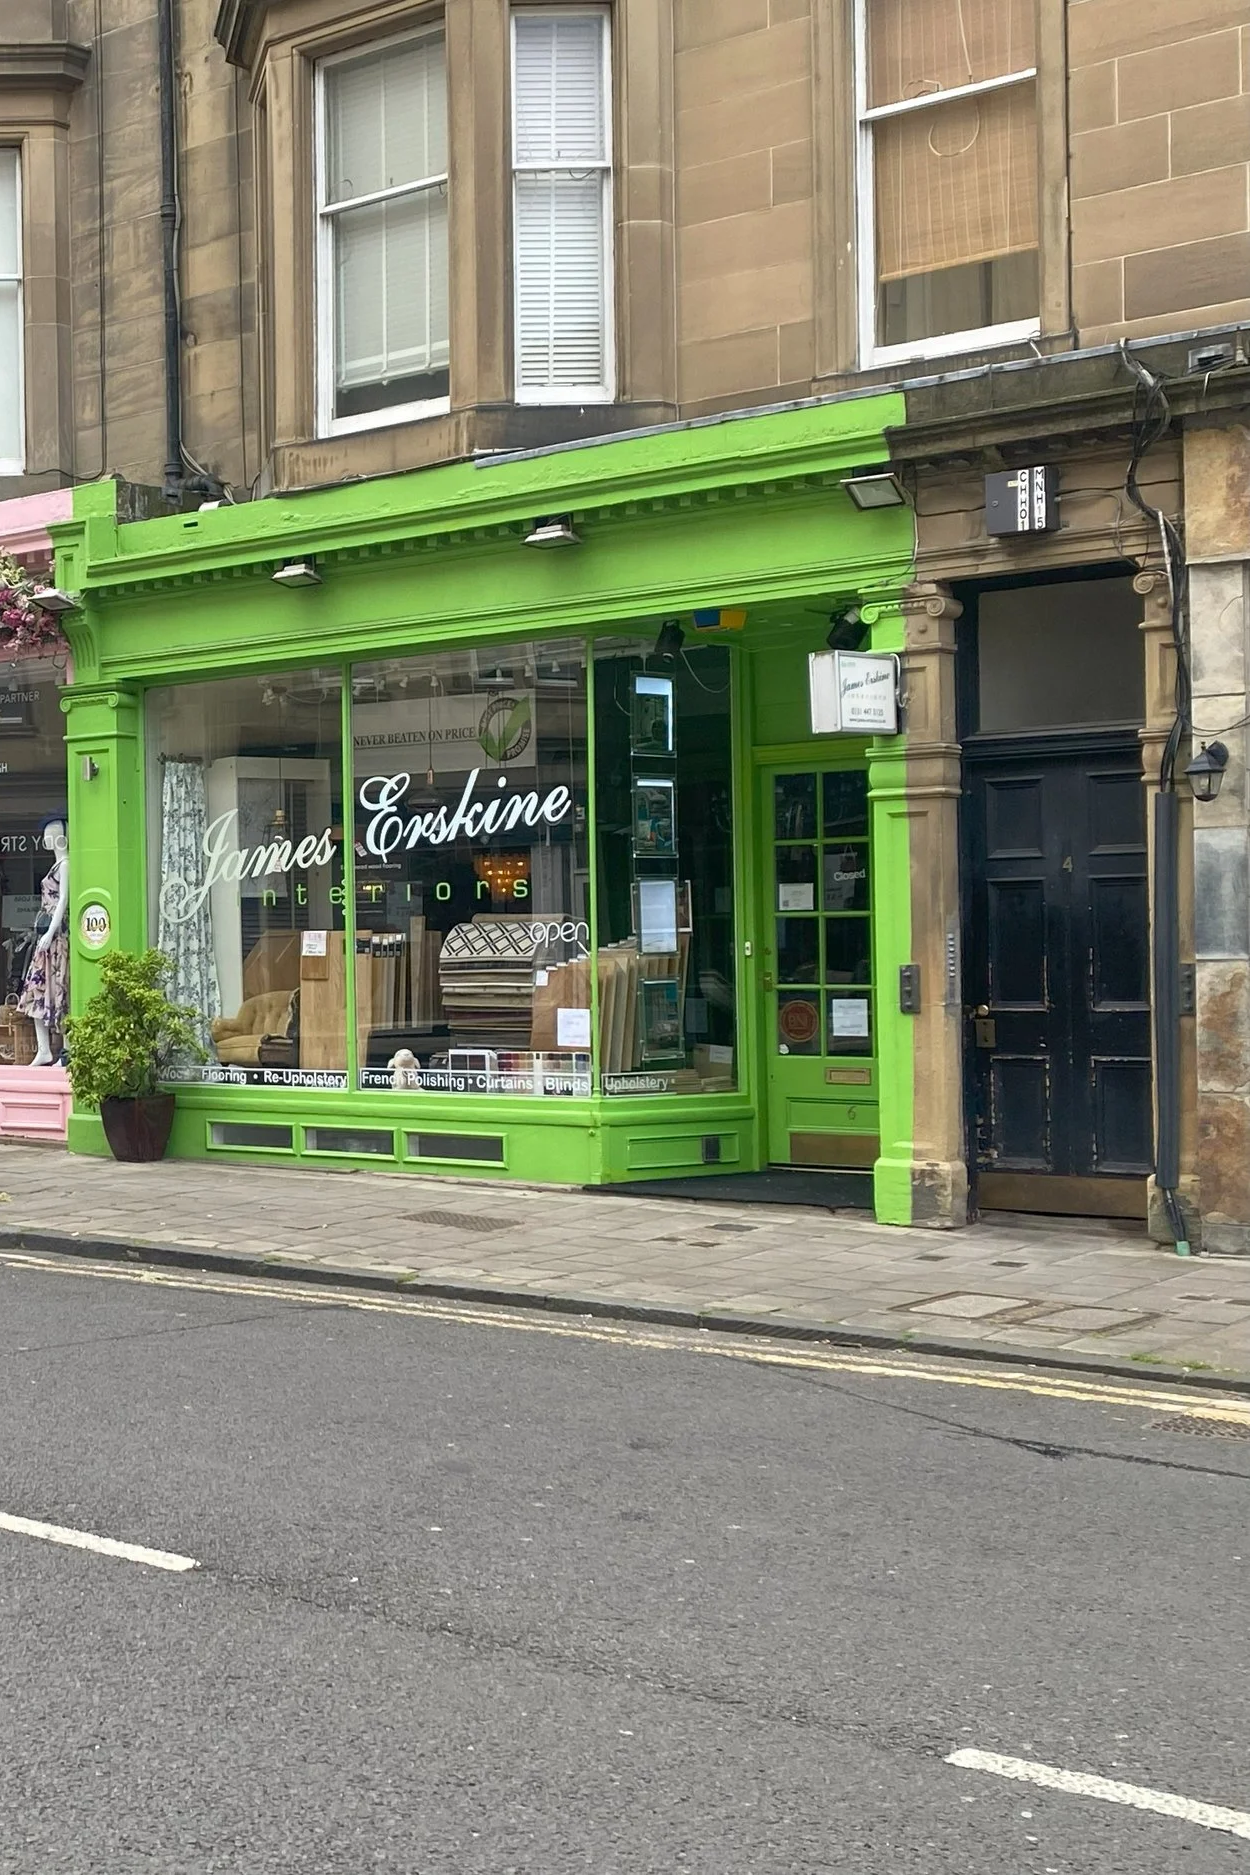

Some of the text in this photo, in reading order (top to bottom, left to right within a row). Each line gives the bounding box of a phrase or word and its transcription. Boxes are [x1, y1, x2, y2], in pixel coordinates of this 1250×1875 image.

[0, 690, 40, 704] PARTNER
[353, 727, 476, 747] NEVER BEATEN ON PRICE
[159, 767, 572, 924] James Erskine
[1062, 855, 1072, 872] 4
[833, 868, 867, 881] Closed
[530, 921, 590, 949] open
[201, 1068, 247, 1084] Flooring
[263, 1071, 347, 1088] Re-Upholstery
[407, 1072, 465, 1089] Polishing
[476, 1076, 534, 1090] Curtains
[545, 1078, 589, 1092] Blinds
[605, 1076, 669, 1094] Upholstery
[847, 1105, 857, 1121] 6
